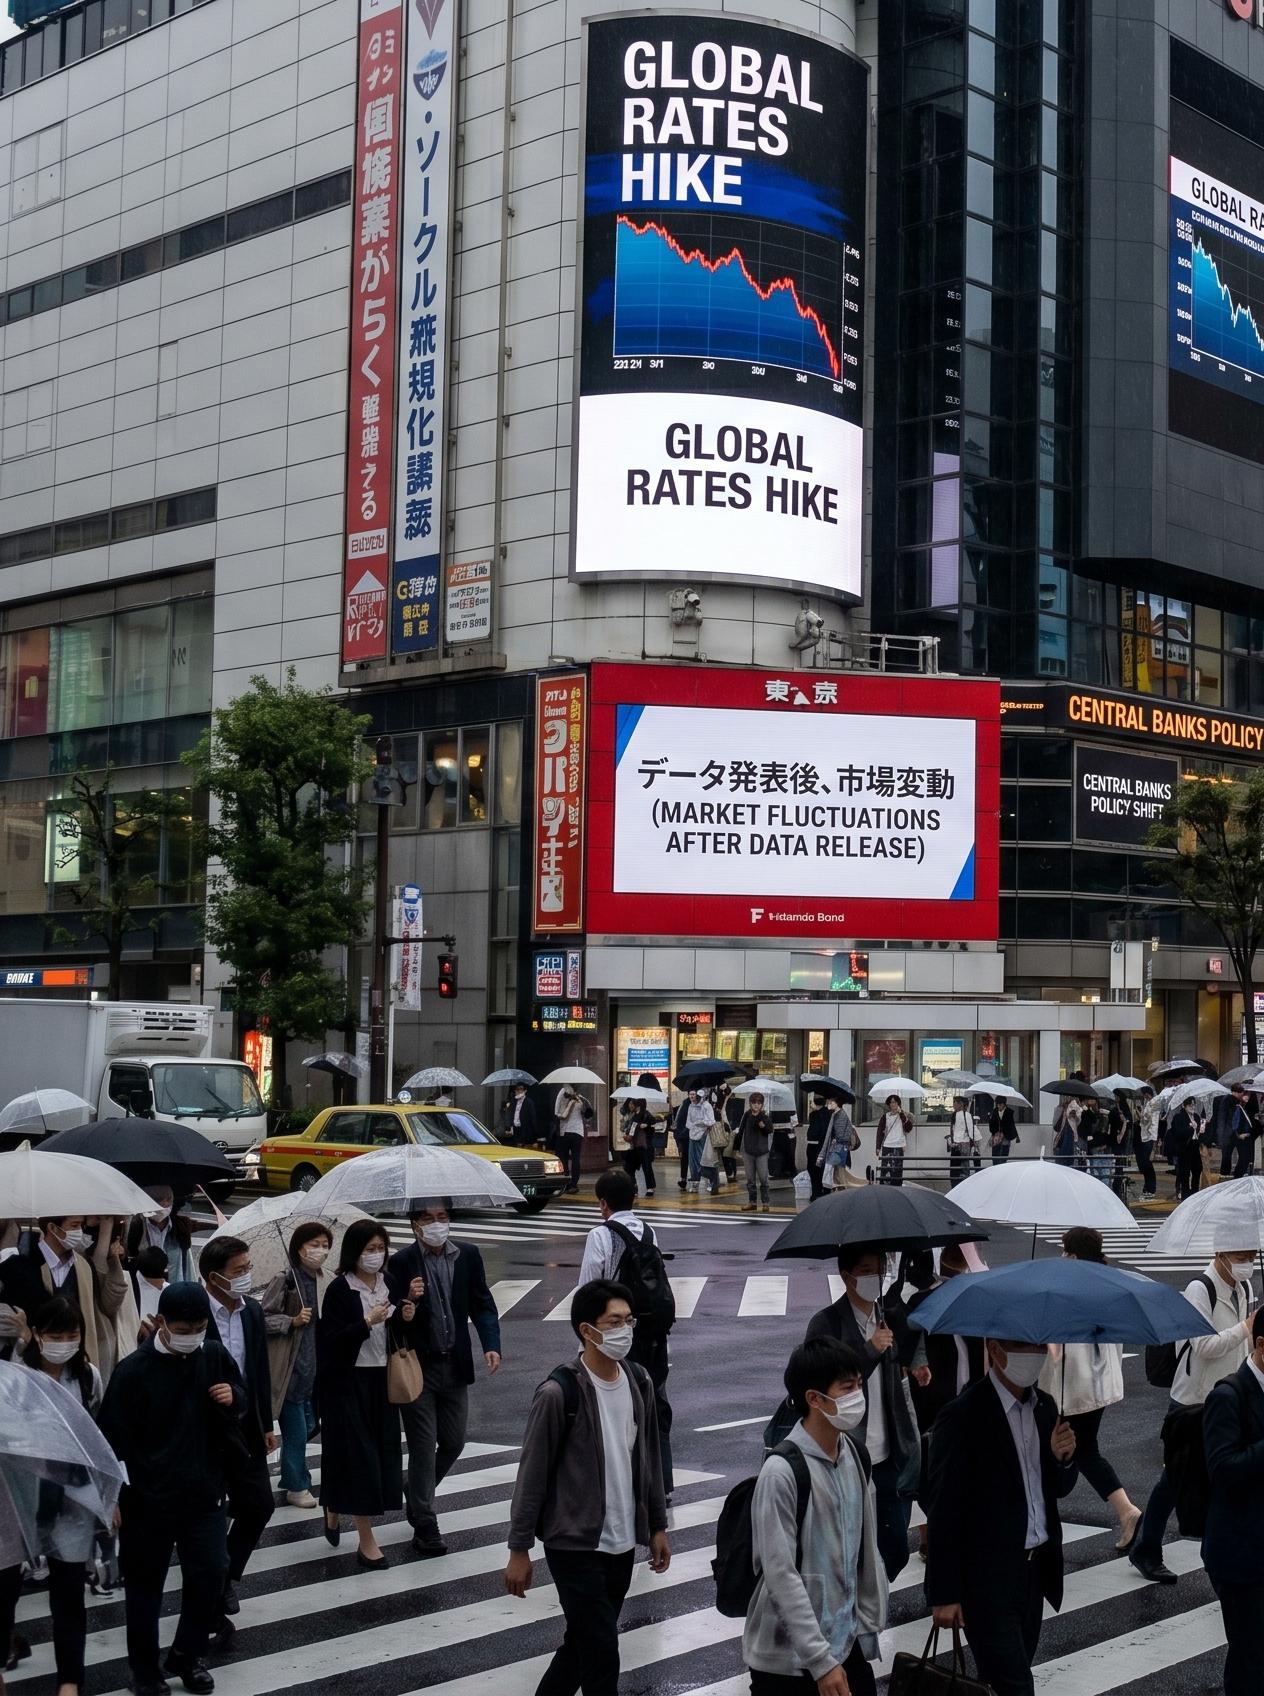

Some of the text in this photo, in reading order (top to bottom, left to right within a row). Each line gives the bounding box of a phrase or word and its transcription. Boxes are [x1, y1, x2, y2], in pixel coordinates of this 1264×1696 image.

[624, 41, 823, 113] GLOBAL
[624, 98, 788, 156] RATES
[621, 154, 742, 206] HIKE
[1191, 177, 1246, 223] GLOBAL
[665, 422, 813, 474] GLOBAL
[626, 468, 838, 525] RATES HIKE
[1069, 694, 1148, 732] CENTRAL
[1152, 709, 1207, 741] BANKS
[1210, 719, 1263, 751] POLICY
[636, 757, 955, 800] データ発表後、市場変動
[1083, 773, 1171, 800] CENTRAL BANKS
[651, 797, 940, 831] (MARKET FLUCTUATIONS
[1090, 795, 1164, 820] POLICY SHIFT
[665, 831, 925, 865] AFTER DATA RELEASE)
